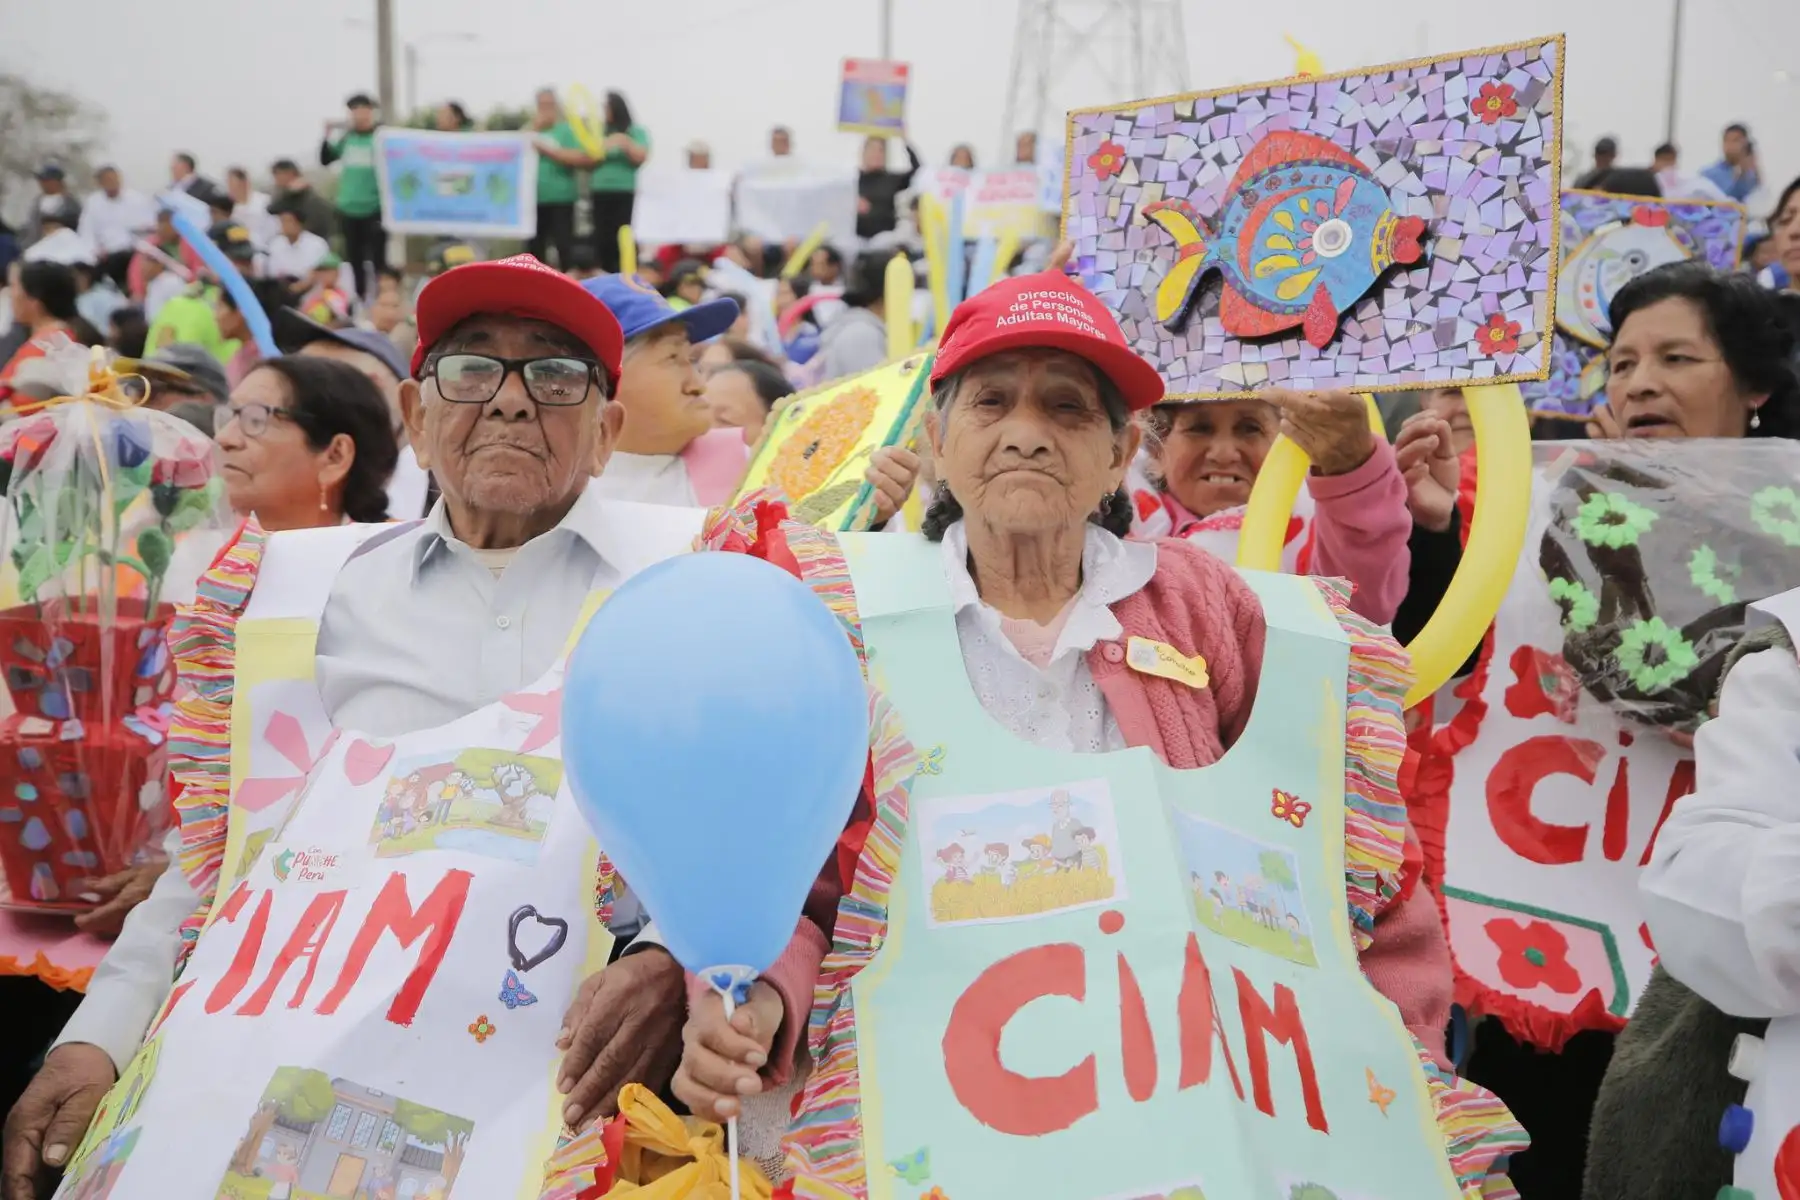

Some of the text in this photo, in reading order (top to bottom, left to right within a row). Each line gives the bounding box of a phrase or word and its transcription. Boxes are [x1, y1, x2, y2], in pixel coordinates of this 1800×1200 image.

[1017, 290, 1084, 308] Dirección
[1009, 300, 1095, 324] de Personas
[996, 311, 1107, 341] Adultas Mayores
